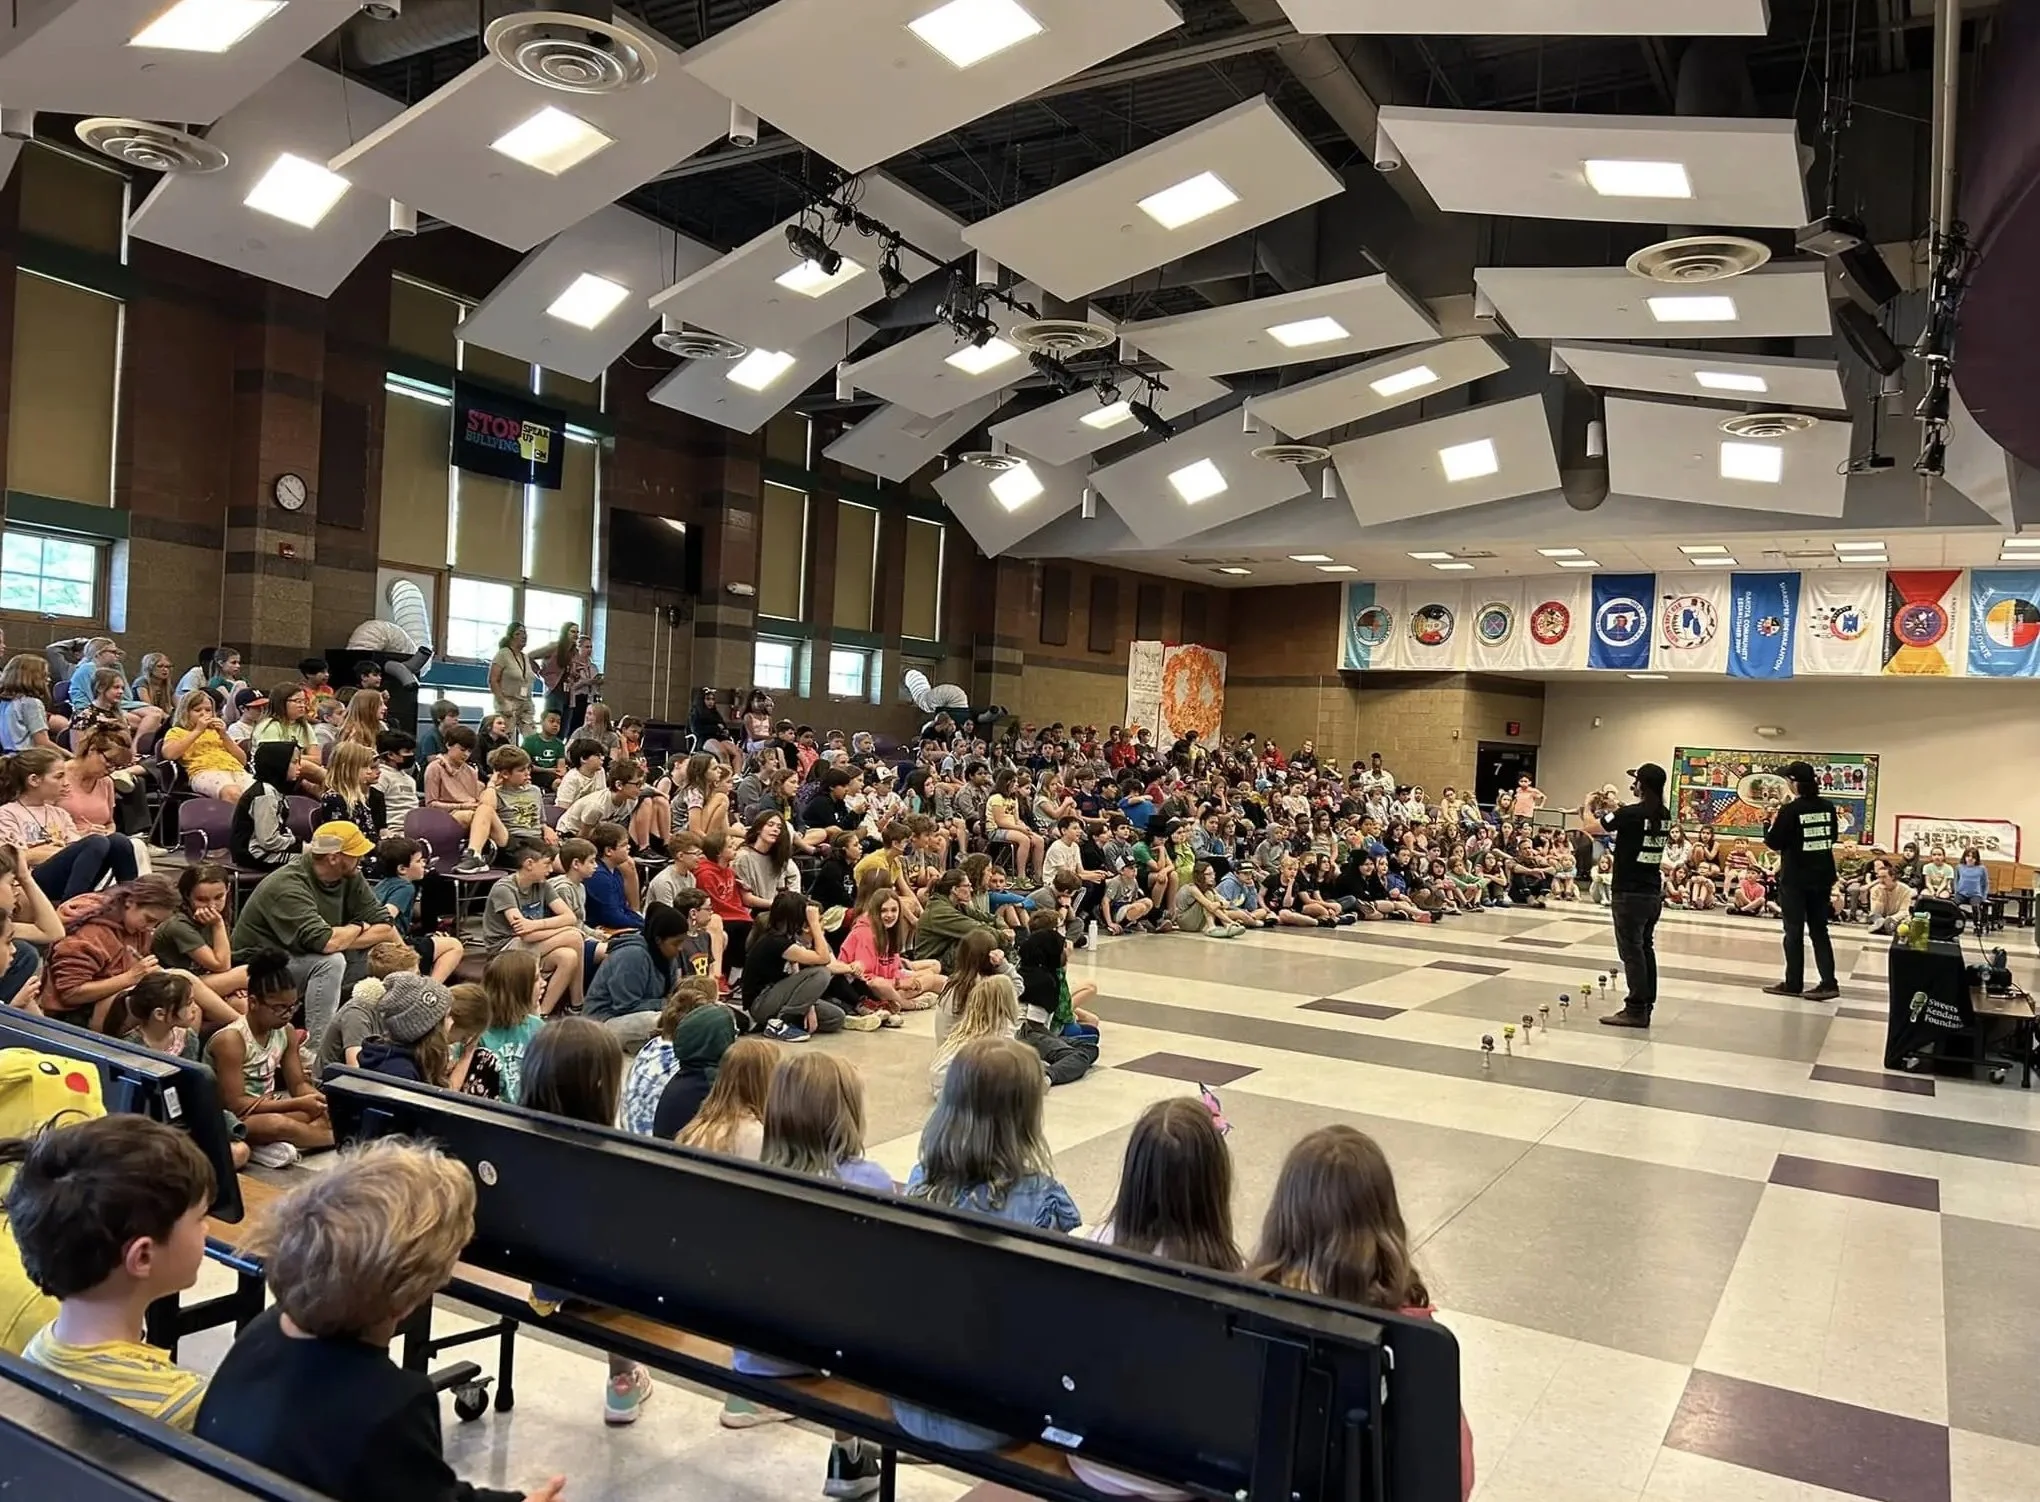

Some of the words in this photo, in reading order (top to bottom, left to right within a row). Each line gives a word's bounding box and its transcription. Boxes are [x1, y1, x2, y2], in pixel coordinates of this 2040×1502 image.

[467, 409, 520, 440] STOP
[523, 425, 549, 438] SPEAK
[466, 430, 520, 453] BULLYING
[522, 433, 534, 443] UP
[1743, 591, 1752, 618] DAKOTA
[1779, 582, 1790, 615] SHAKOPEE
[1741, 619, 1750, 661] COMMUNITY
[1493, 763, 1502, 776] 7
[1914, 832, 2000, 852] HEROES
